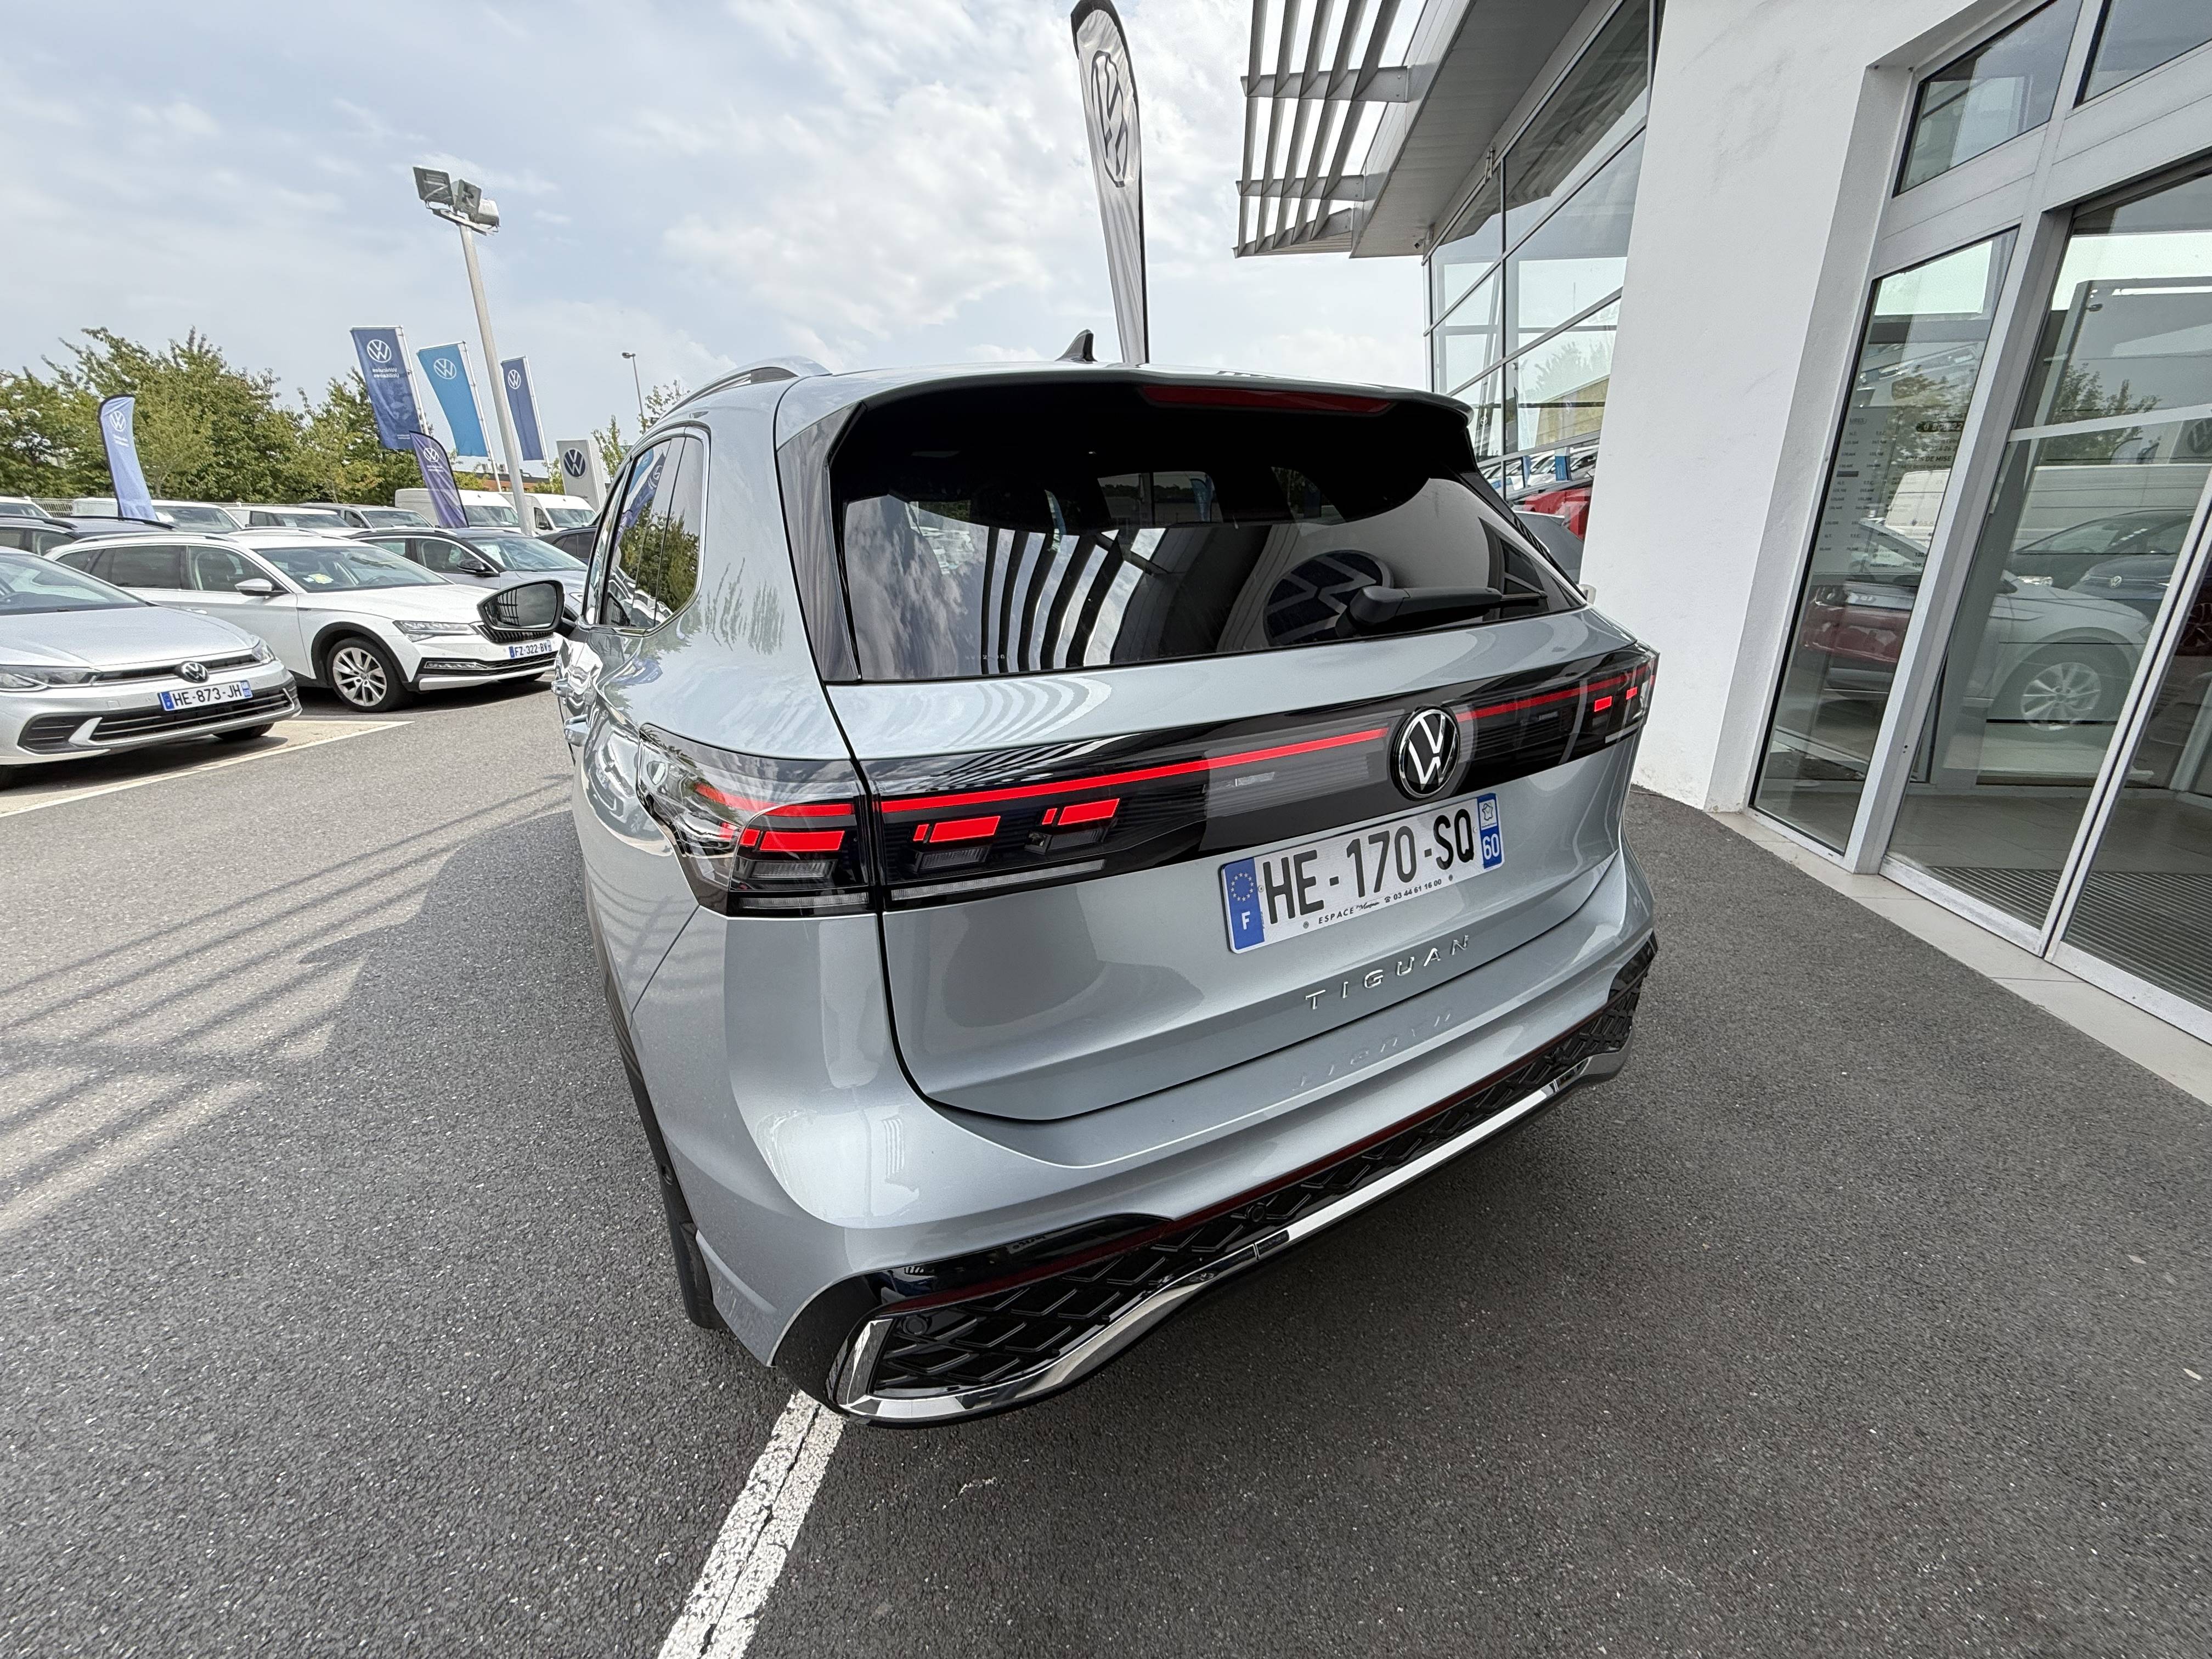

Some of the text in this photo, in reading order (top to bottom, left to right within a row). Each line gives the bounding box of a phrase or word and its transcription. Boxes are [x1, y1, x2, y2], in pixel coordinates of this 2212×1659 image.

[172, 684, 242, 707] HE-873-JH
[1242, 911, 1251, 930] F
[1263, 809, 1475, 924] HE-170-SQ
[1482, 833, 1500, 861] 60
[1434, 878, 1442, 887] 00
[1318, 907, 1354, 924] ESPACE
[1305, 935, 1469, 1010] TIGUAN
